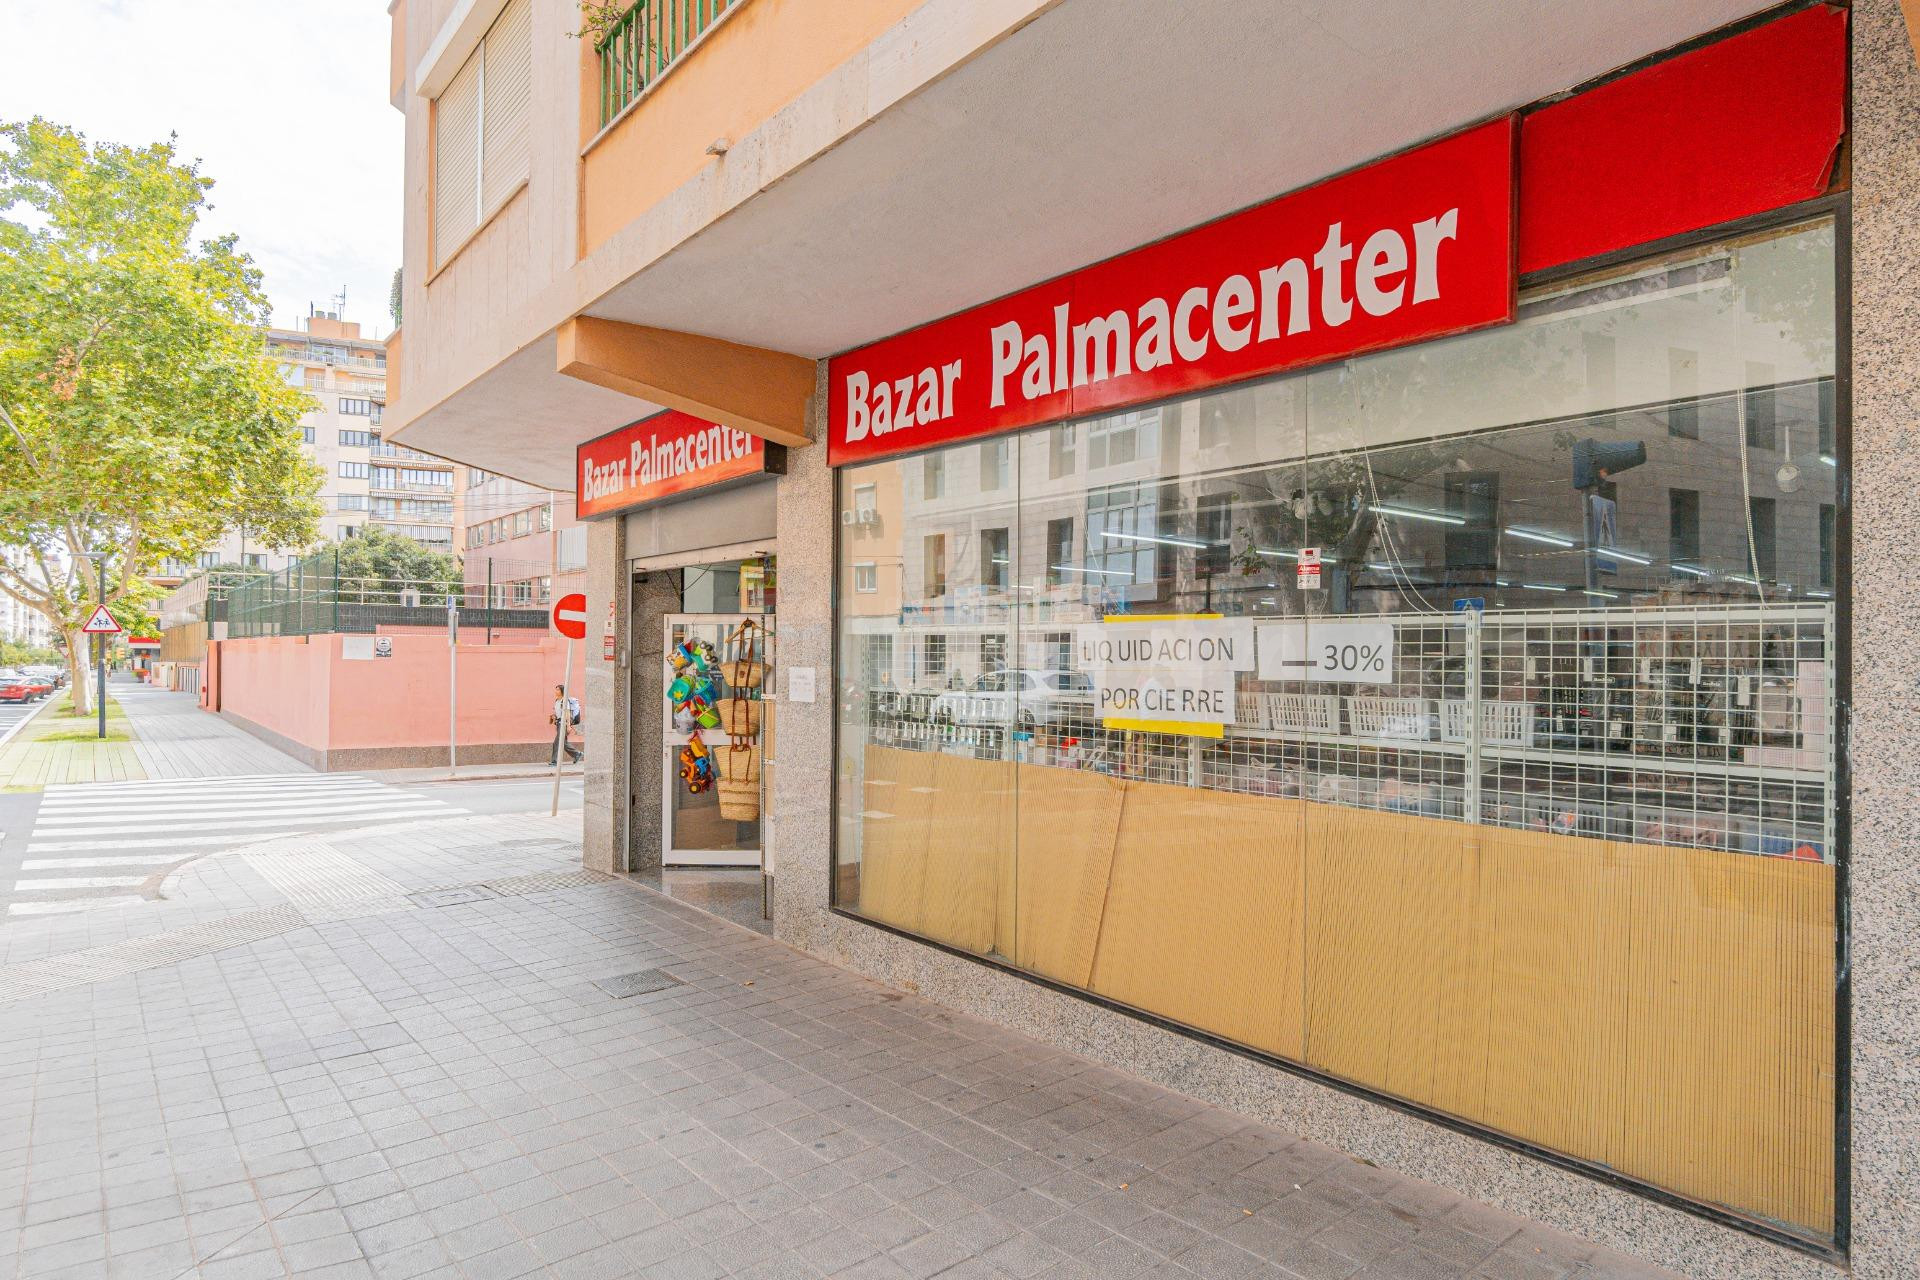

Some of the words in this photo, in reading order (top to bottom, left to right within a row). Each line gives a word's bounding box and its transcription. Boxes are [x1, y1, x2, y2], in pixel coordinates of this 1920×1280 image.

[845, 358, 961, 444] Bazar
[989, 207, 1459, 408] Palmacenter
[583, 458, 626, 503] Bazar
